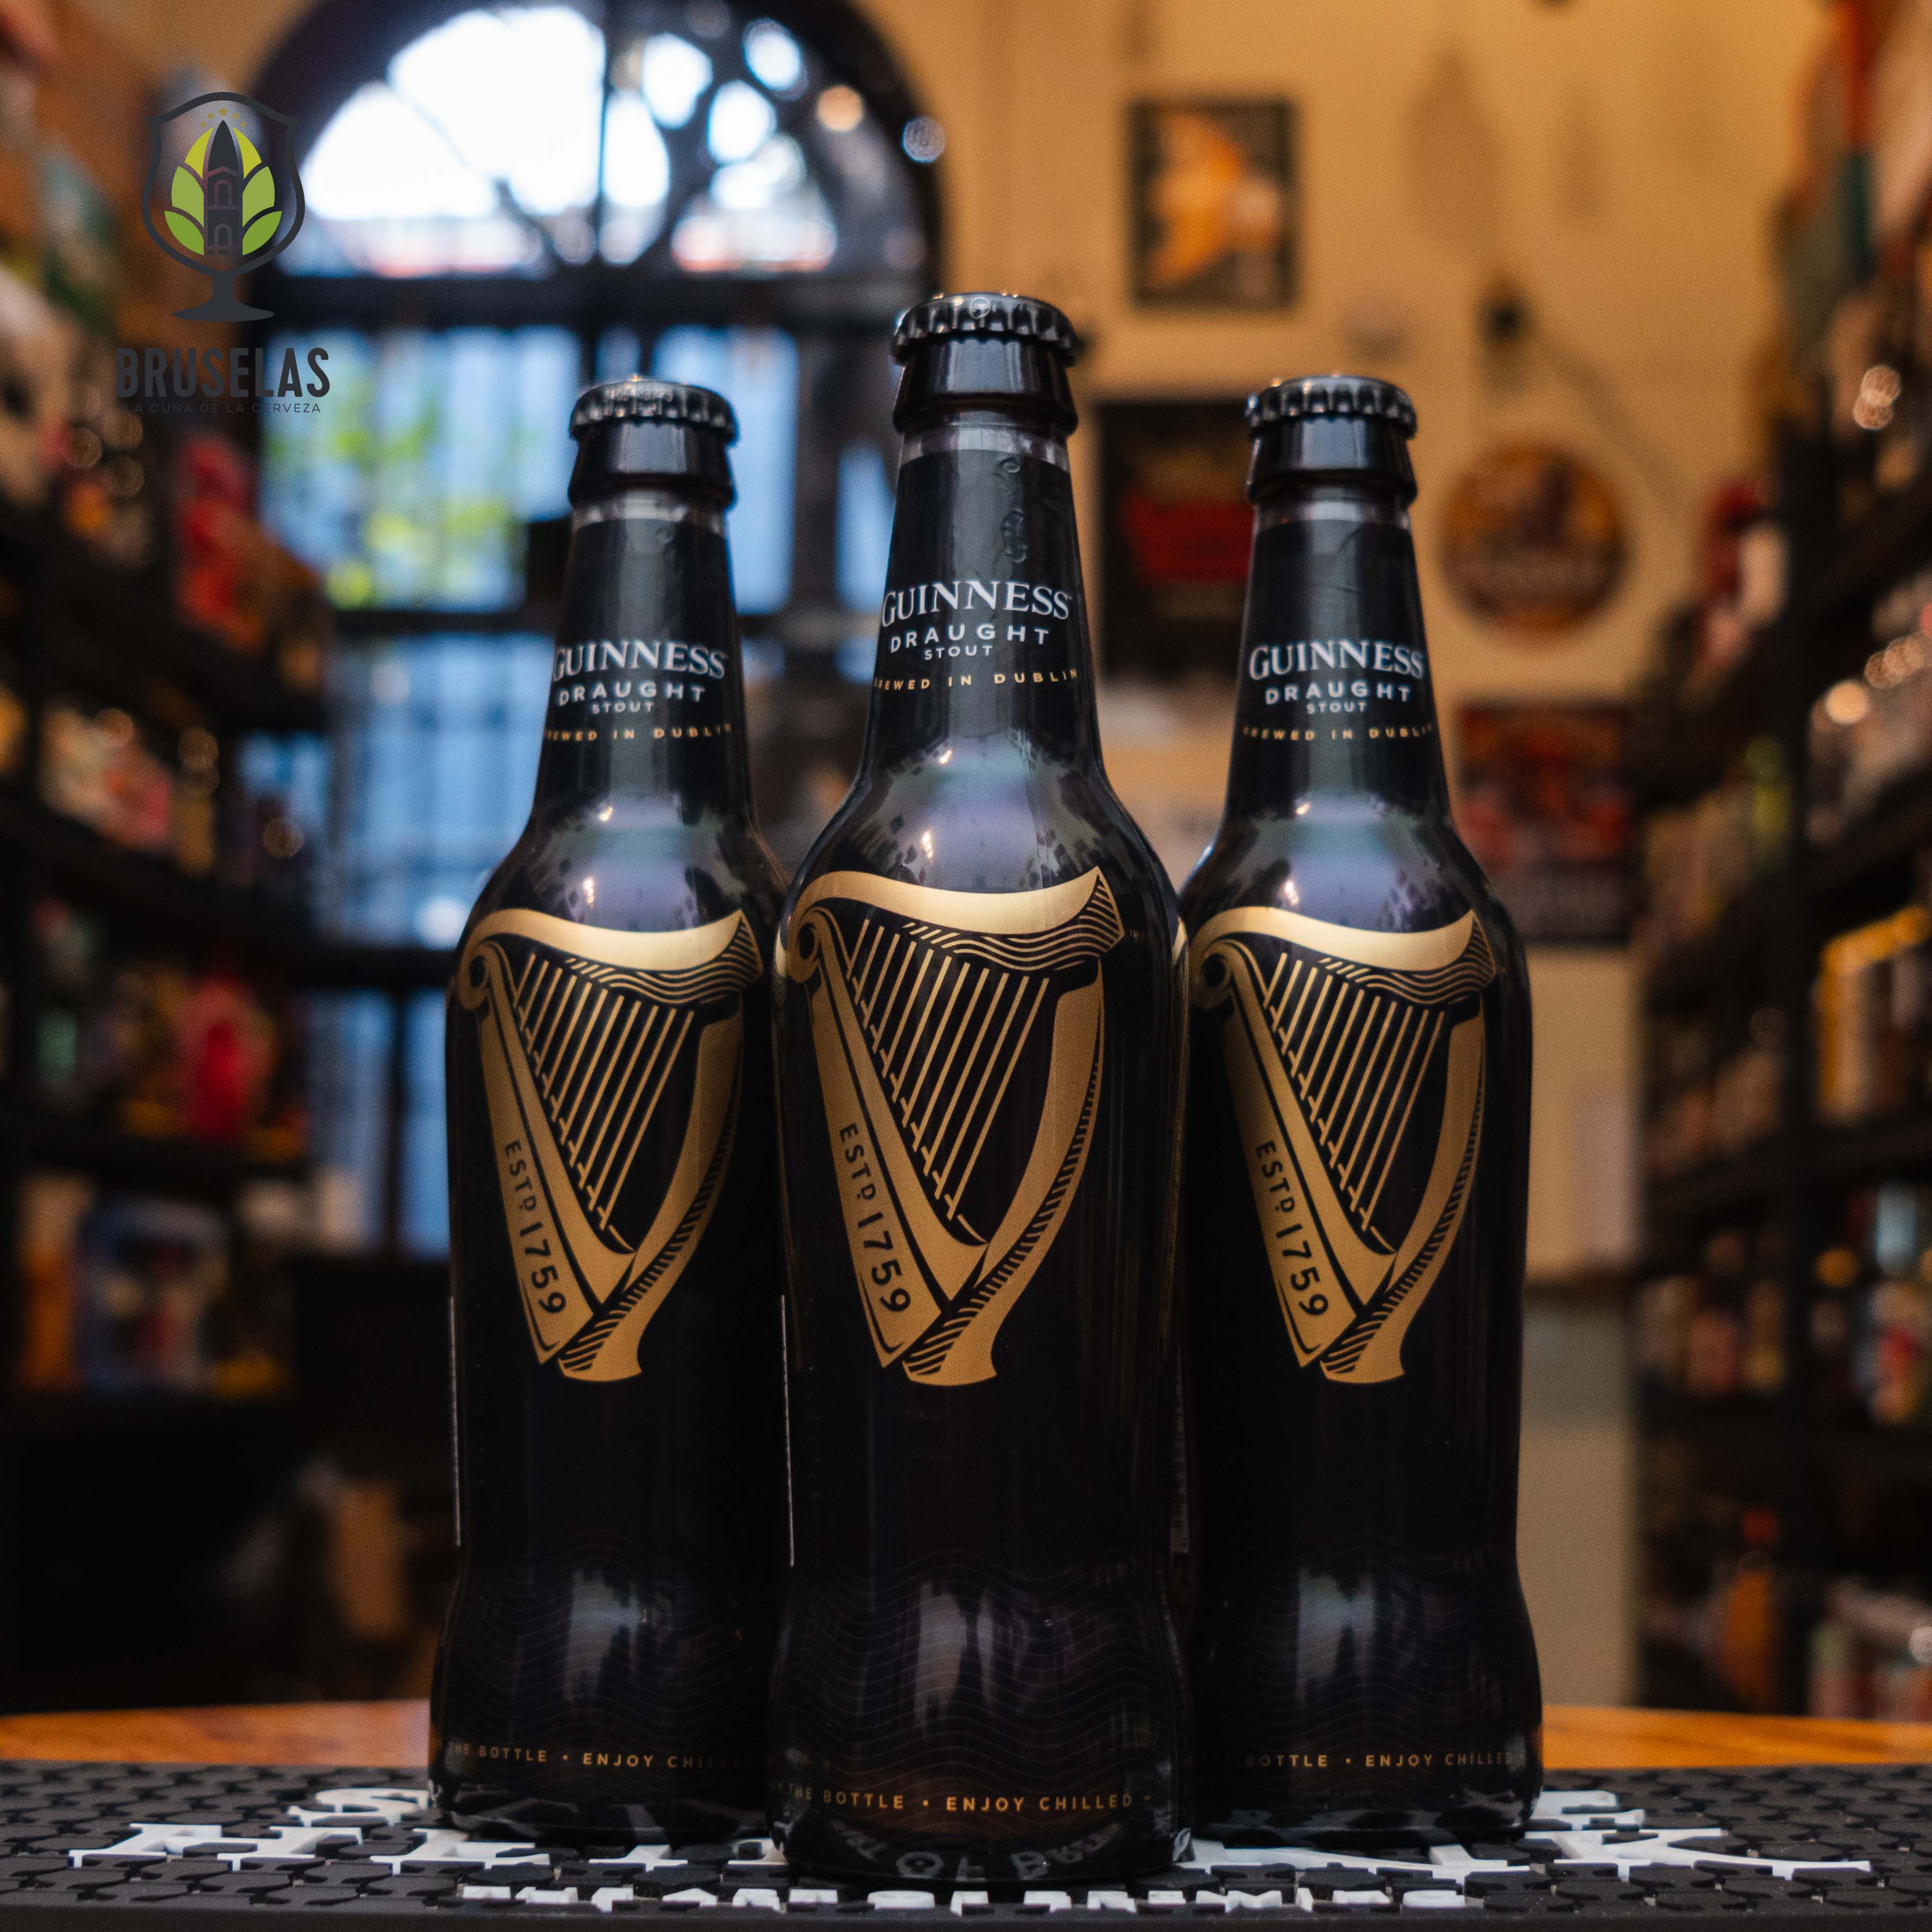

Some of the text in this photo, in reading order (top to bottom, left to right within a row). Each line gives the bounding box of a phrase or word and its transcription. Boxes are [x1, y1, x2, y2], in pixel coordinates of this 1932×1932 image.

[882, 580, 1069, 627] GUINNESS
[890, 623, 1049, 653] DRAUGHT
[553, 640, 726, 682] GUINNESS
[925, 646, 993, 660] STOUT
[1249, 639, 1424, 680] GUINNESS
[948, 675, 971, 686] IN
[994, 668, 1077, 684] DUBLIN
[559, 681, 706, 706] DRAUGHT
[1265, 681, 1411, 705] DRAUGHT
[591, 702, 654, 714] STOUT
[1306, 701, 1367, 715] STOUT
[613, 729, 635, 739] IN
[1331, 729, 1353, 739] IN
[519, 1222, 567, 1313] 1759
[857, 1212, 911, 1312] 1759
[1276, 1223, 1329, 1316] 1759
[478, 1745, 547, 1762] BOTTLE
[582, 1752, 655, 1768] ENJOY
[1365, 1753, 1433, 1767] ENJOY
[1444, 1751, 1513, 1765] CHILLED
[823, 1789, 904, 1809] BOTTLE
[946, 1796, 1026, 1812] ENJOY
[1039, 1792, 1133, 1811] CHILLED
